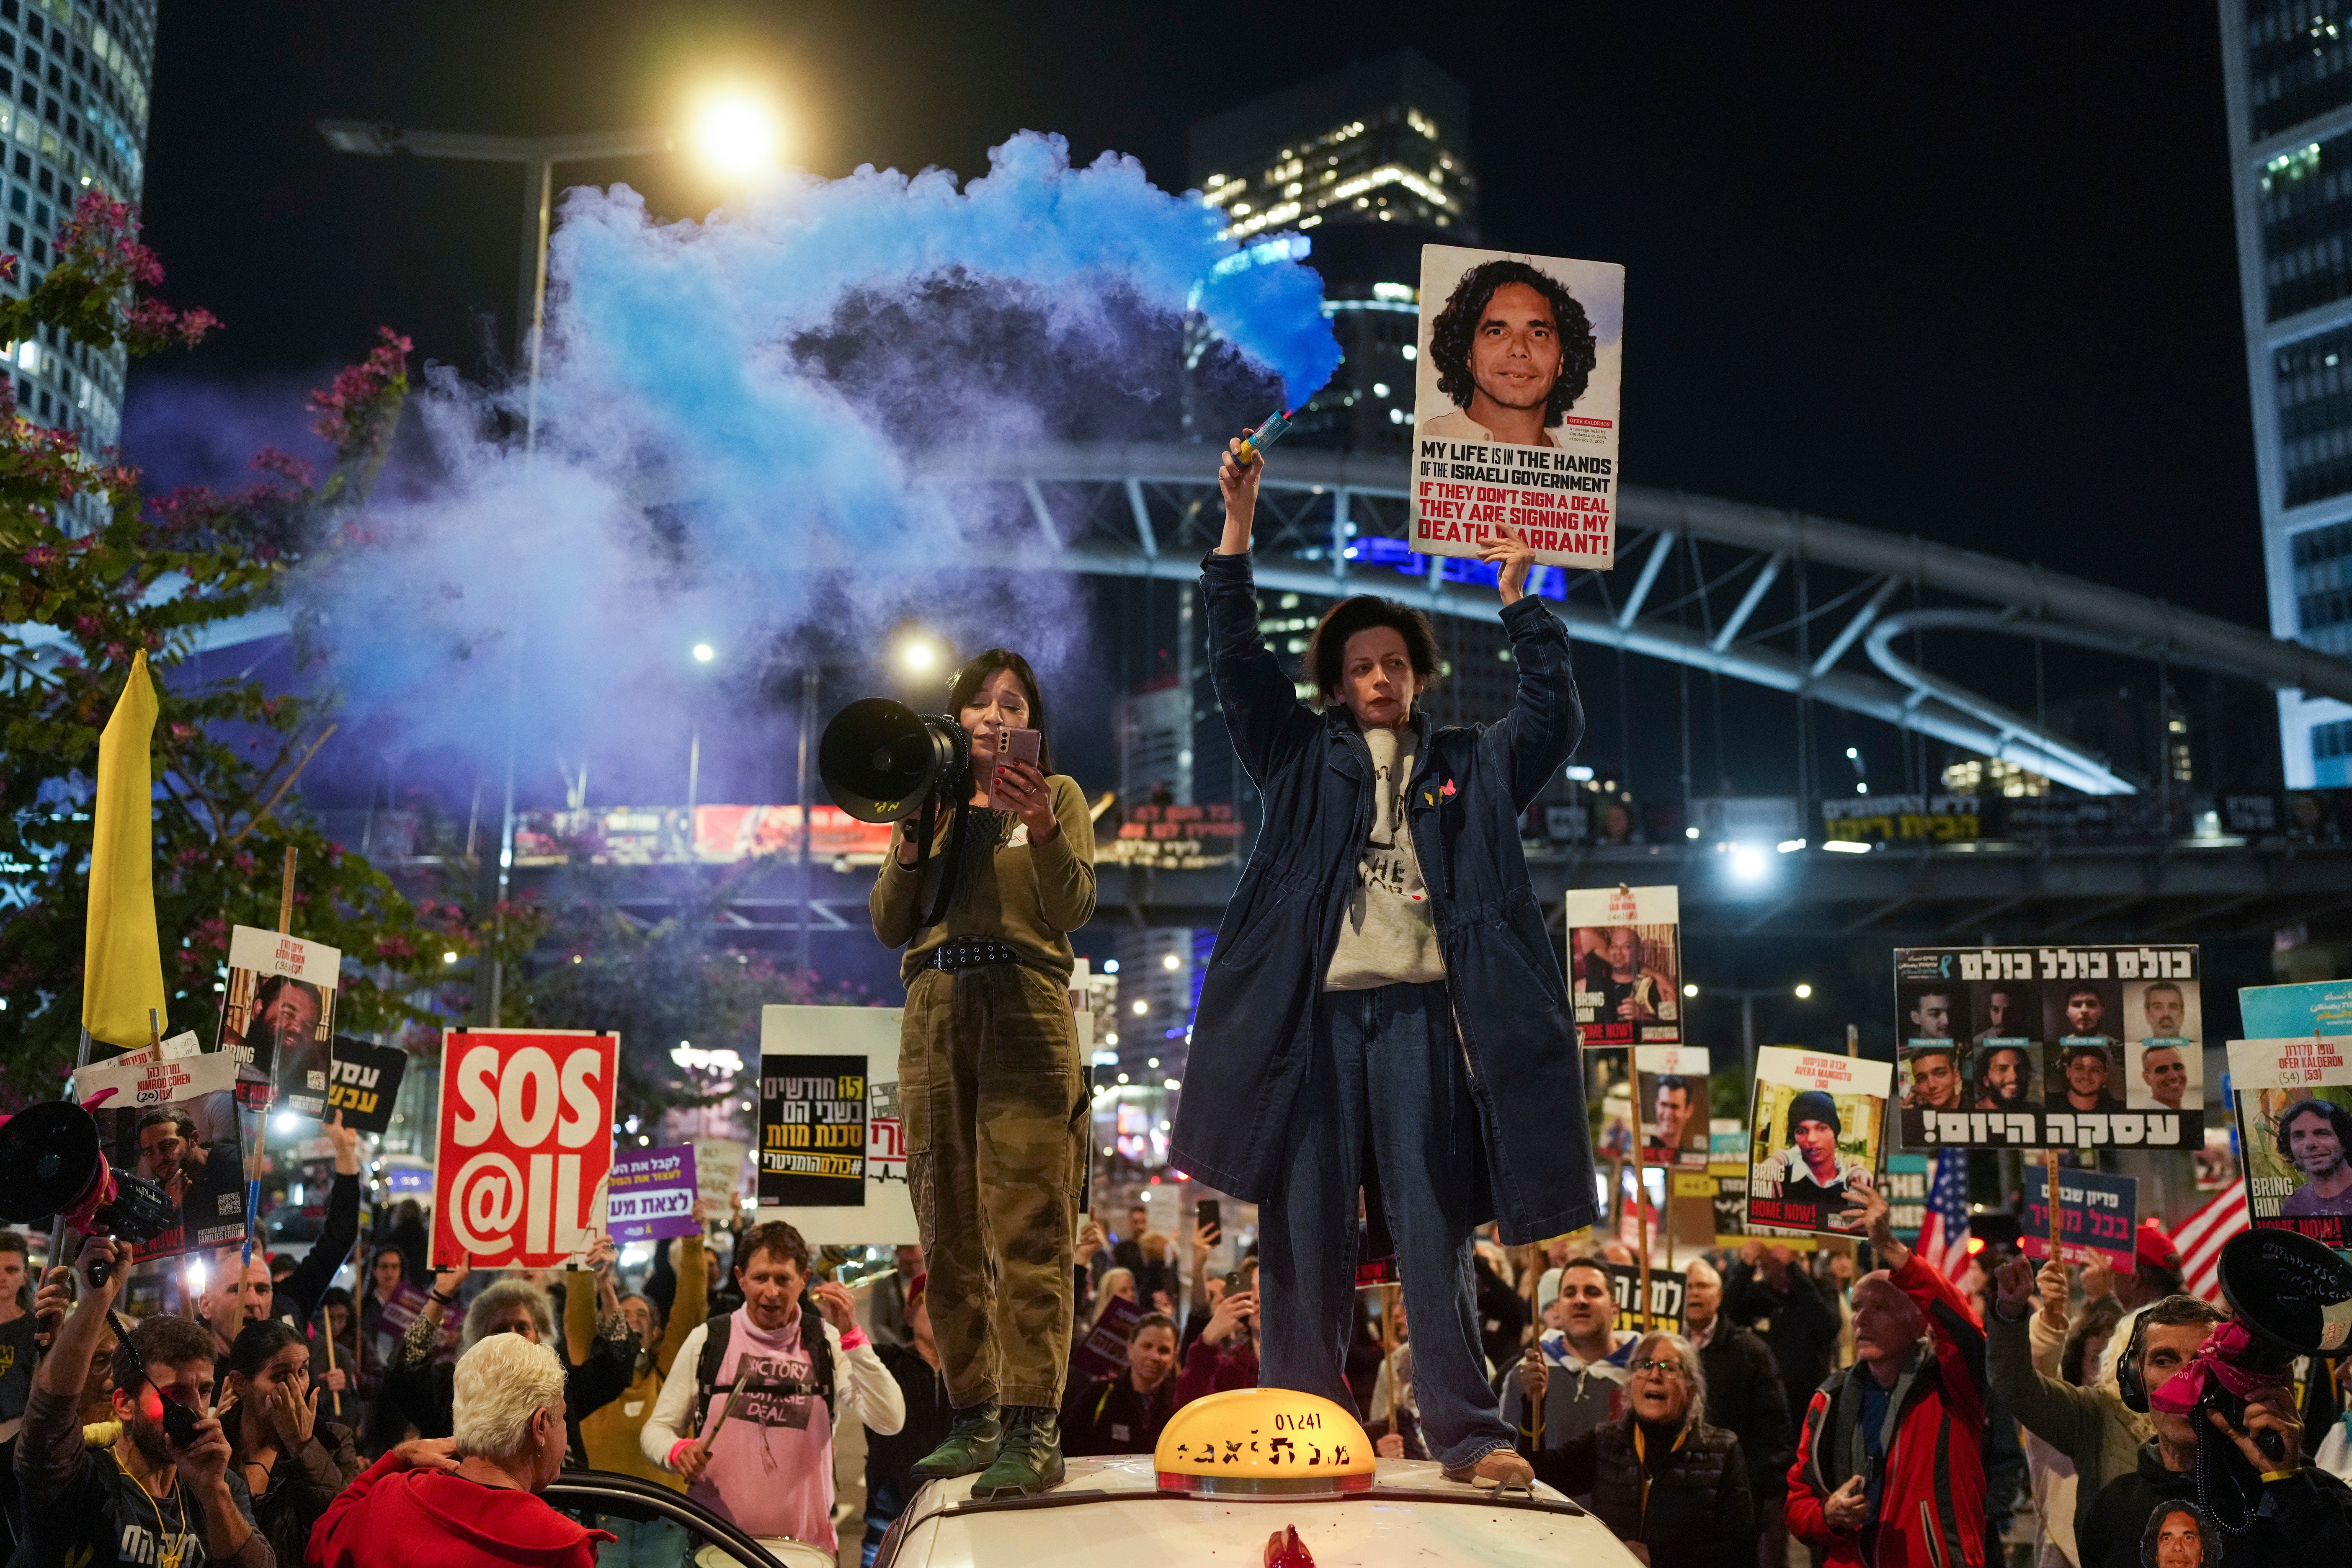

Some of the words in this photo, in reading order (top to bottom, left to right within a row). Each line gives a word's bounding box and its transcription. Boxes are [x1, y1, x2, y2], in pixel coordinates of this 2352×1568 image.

[1253, 432, 1270, 446] SMOKE
[1269, 420, 1282, 432] TUBE
[1261, 416, 1277, 432] COLOR
[1421, 441, 1447, 459] MY
[1451, 444, 1488, 463] LIFE
[1492, 447, 1501, 464] IS
[1504, 449, 1513, 465] IN
[1517, 450, 1550, 469] THE
[1554, 454, 1611, 475] HANDS
[1421, 461, 1432, 476] OF
[1433, 462, 1447, 478] THE
[1451, 464, 1508, 483] ISRAELI
[1511, 470, 1610, 493] GOVERNMENT
[1420, 481, 1434, 496] IF
[1436, 483, 1474, 500] THEY
[1477, 487, 1519, 505] DON'T
[1521, 491, 1554, 508] SIGN
[1557, 495, 1568, 509] A
[1571, 496, 1609, 513] DEAL
[1420, 499, 1465, 519] THEY
[1469, 504, 1506, 523] ARE
[1510, 508, 1578, 529] SIGNING
[1583, 514, 1609, 532] MY
[1418, 519, 1489, 544] DEATH
[1960, 949, 2032, 981] כולם
[2039, 949, 2109, 980] כולל
[2116, 948, 2192, 980] כולם
[1575, 992, 1604, 1007] BRING
[1576, 1007, 1594, 1022] HIM
[1578, 1024, 1603, 1039] OME
[1607, 1021, 1633, 1038] NOW!
[147, 1067, 160, 1079] כהן
[1795, 1066, 1816, 1076] AVERA
[2279, 1058, 2299, 1069] OFER
[2301, 1056, 2344, 1069] KALDERON
[137, 1078, 167, 1091] NIMROD
[168, 1073, 191, 1087] COHEN
[2279, 1071, 2299, 1086] (54)
[2305, 1068, 2322, 1081] (53)
[137, 1089, 159, 1102] (20)
[454, 1045, 602, 1148] SOS
[764, 1077, 836, 1100] חודשים
[783, 1101, 810, 1124] הם
[815, 1101, 863, 1124] בשבי
[766, 1124, 810, 1147] מוות
[814, 1124, 863, 1147] סכנת
[1923, 1109, 2036, 1144] היום!
[2045, 1113, 2180, 1148] עסקה
[631, 1161, 649, 1173] את
[651, 1155, 680, 1171] לקבל
[763, 1153, 863, 1175] #כולםהומניטרי
[1753, 1164, 1785, 1182] BRING
[634, 1174, 650, 1184] את
[1752, 1181, 1773, 1198] HIM
[2251, 1177, 2294, 1197] BRING
[449, 1152, 594, 1256] @IL
[642, 1193, 688, 1214] לצאת
[1751, 1200, 1782, 1219] HOME
[1785, 1203, 1816, 1222] NOW!
[2254, 1197, 2281, 1217] HIM
[198, 1227, 217, 1236] HOSTAGES
[227, 1222, 244, 1231] MISSING
[2089, 1208, 2129, 1240] בכל
[2299, 1217, 2342, 1238] NOW!
[198, 1232, 224, 1244] FAMILIES
[224, 1228, 245, 1240] FORUM
[747, 1403, 787, 1421] DEAL
[1275, 1413, 1321, 1430] 01241
